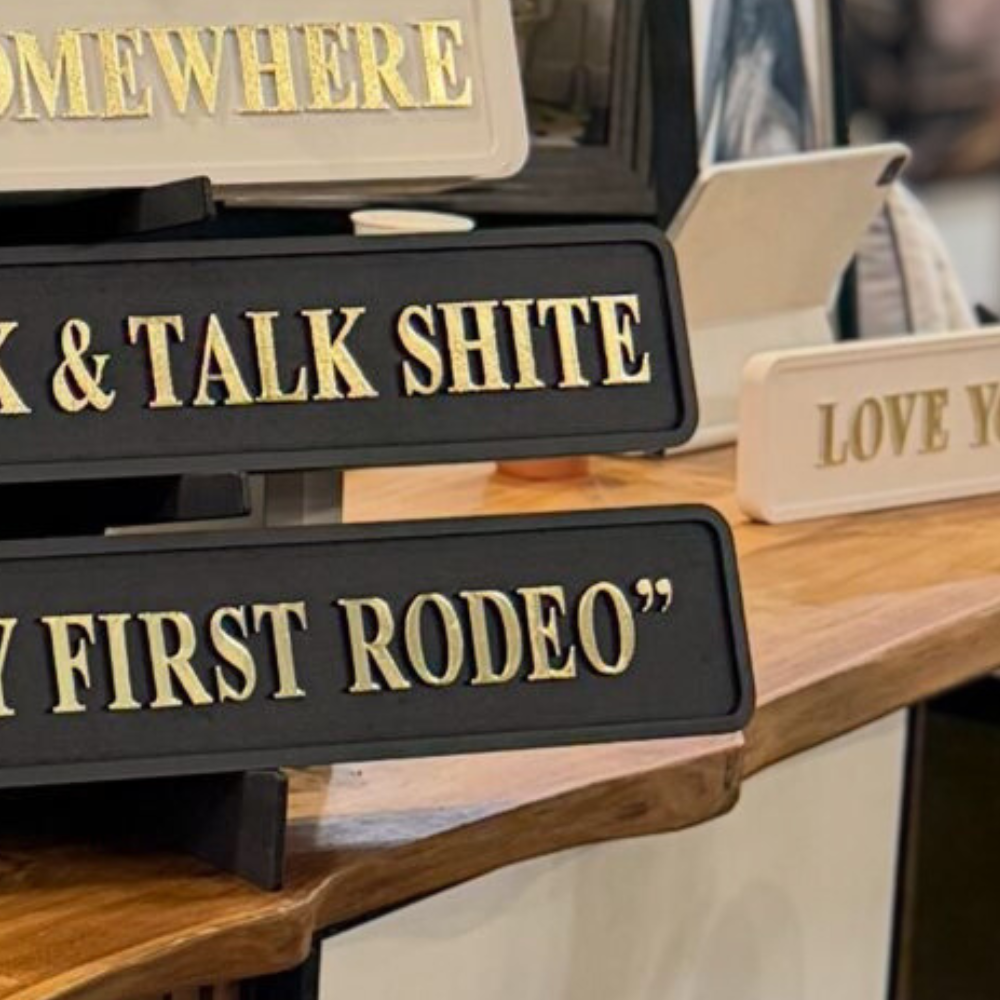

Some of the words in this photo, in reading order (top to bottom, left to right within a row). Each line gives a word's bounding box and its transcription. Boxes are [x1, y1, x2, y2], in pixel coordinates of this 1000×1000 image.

[52, 318, 115, 413] &
[128, 306, 377, 409] TALK
[399, 294, 652, 398] SHITE
[814, 387, 949, 470] LOVE
[963, 381, 1000, 449] Y
[38, 600, 309, 715] FIRST
